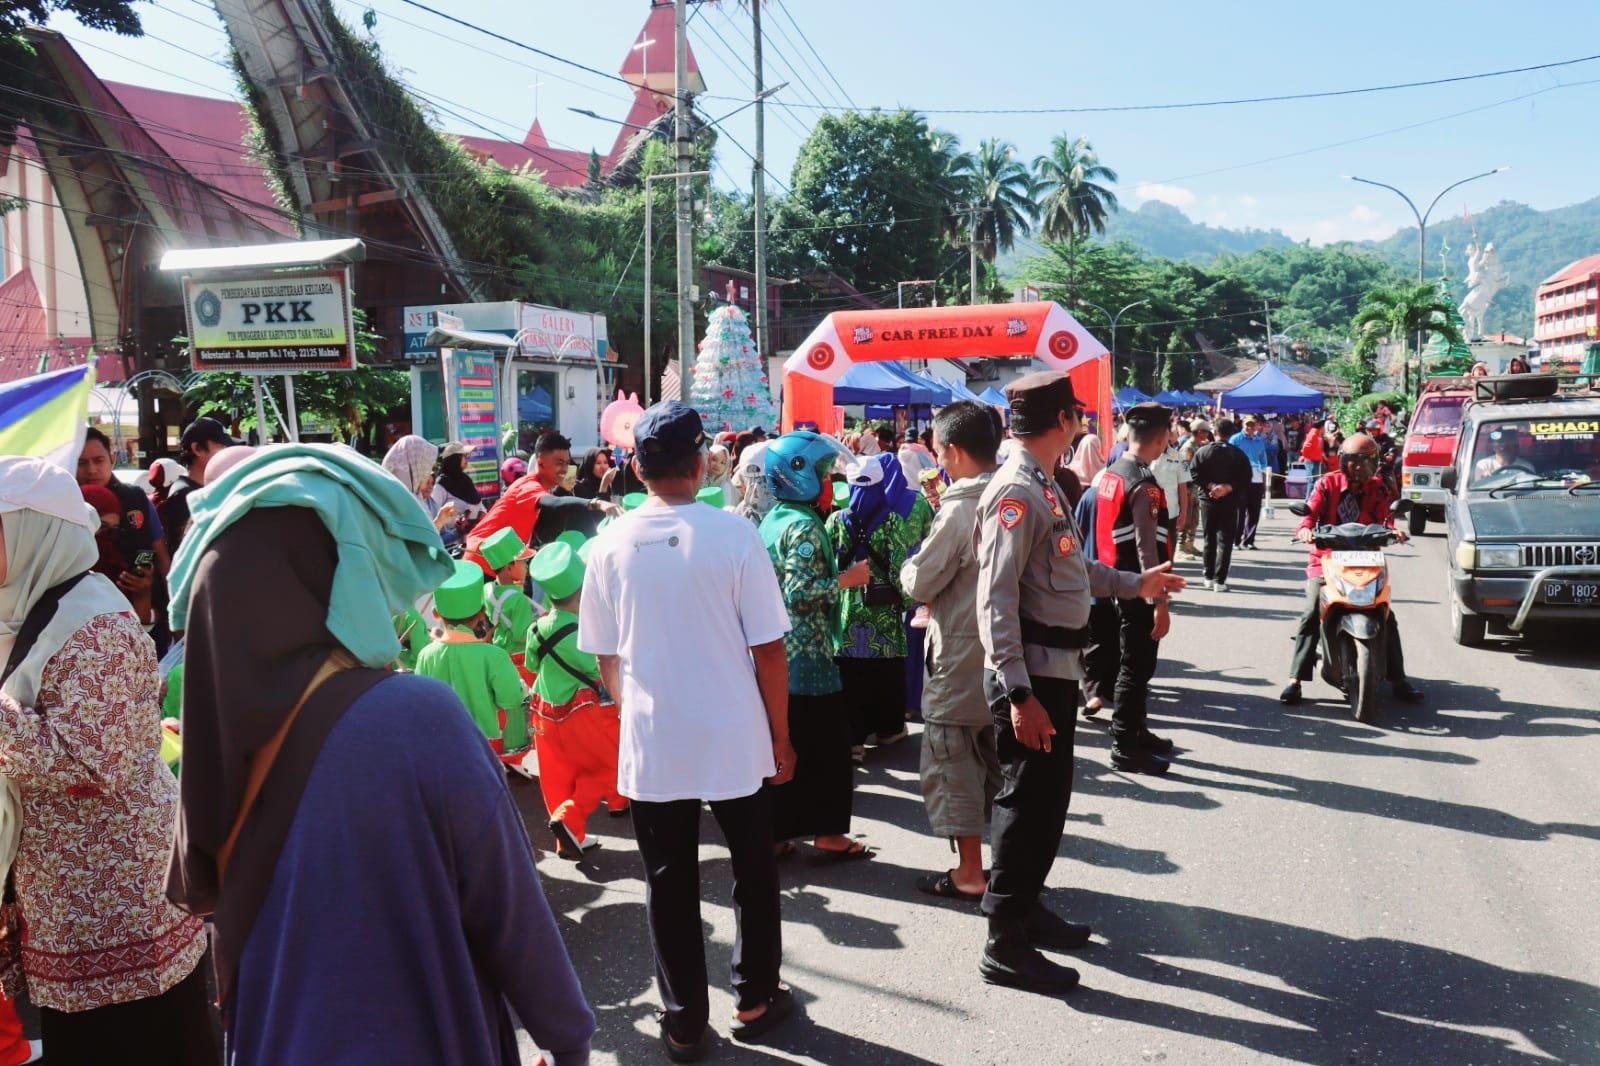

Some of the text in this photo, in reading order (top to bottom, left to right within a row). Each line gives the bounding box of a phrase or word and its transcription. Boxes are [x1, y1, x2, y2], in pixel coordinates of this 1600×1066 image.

[241, 300, 315, 324] PKK
[541, 314, 577, 332] GALERY
[409, 336, 425, 349] AT
[881, 325, 995, 343] CAR FREE DAY
[1547, 584, 1598, 598] DP 1802
